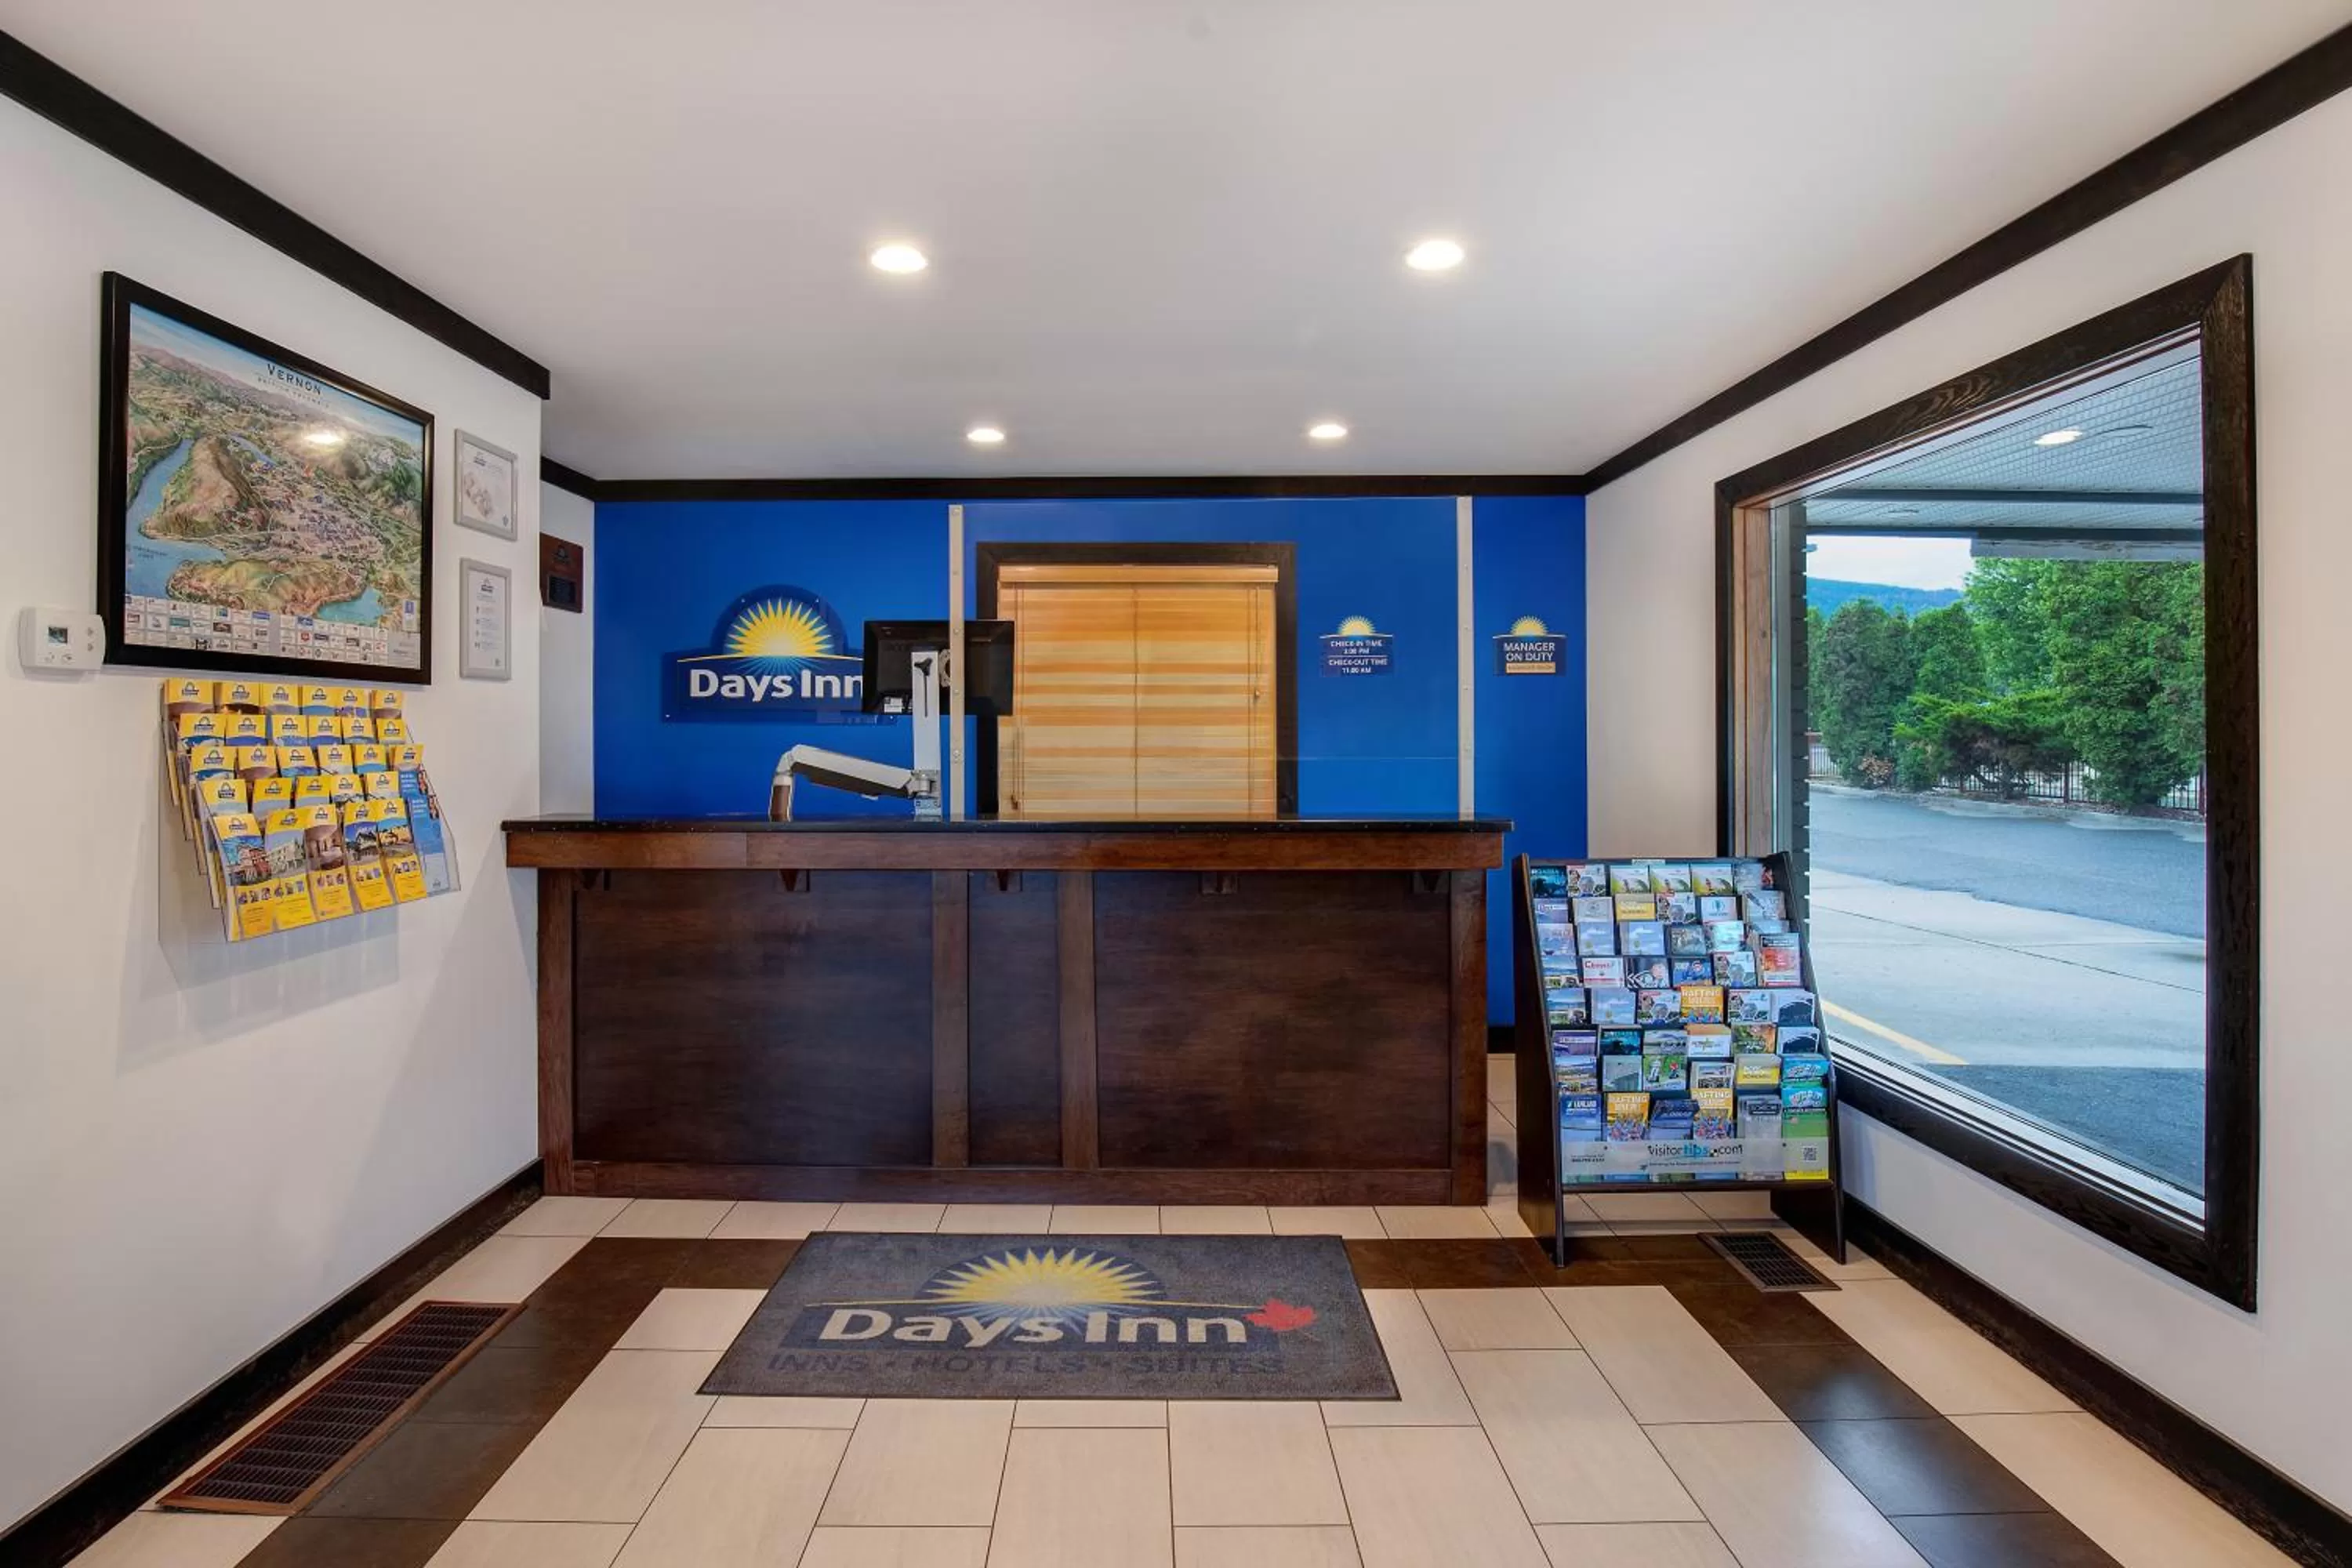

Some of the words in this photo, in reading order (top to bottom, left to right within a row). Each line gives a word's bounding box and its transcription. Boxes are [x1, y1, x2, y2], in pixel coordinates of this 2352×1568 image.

[267, 362, 321, 396] VERNON
[1504, 642, 1555, 652] MANAGER
[1506, 652, 1523, 662] ON
[1525, 652, 1554, 661] DUTY
[689, 669, 793, 702] Days
[800, 669, 863, 698] Inn
[818, 1308, 1064, 1348] Days
[1084, 1312, 1248, 1342] Inn
[767, 1354, 868, 1372] INNS
[910, 1354, 1086, 1374] HOTELS
[1124, 1353, 1285, 1374] SUITES
